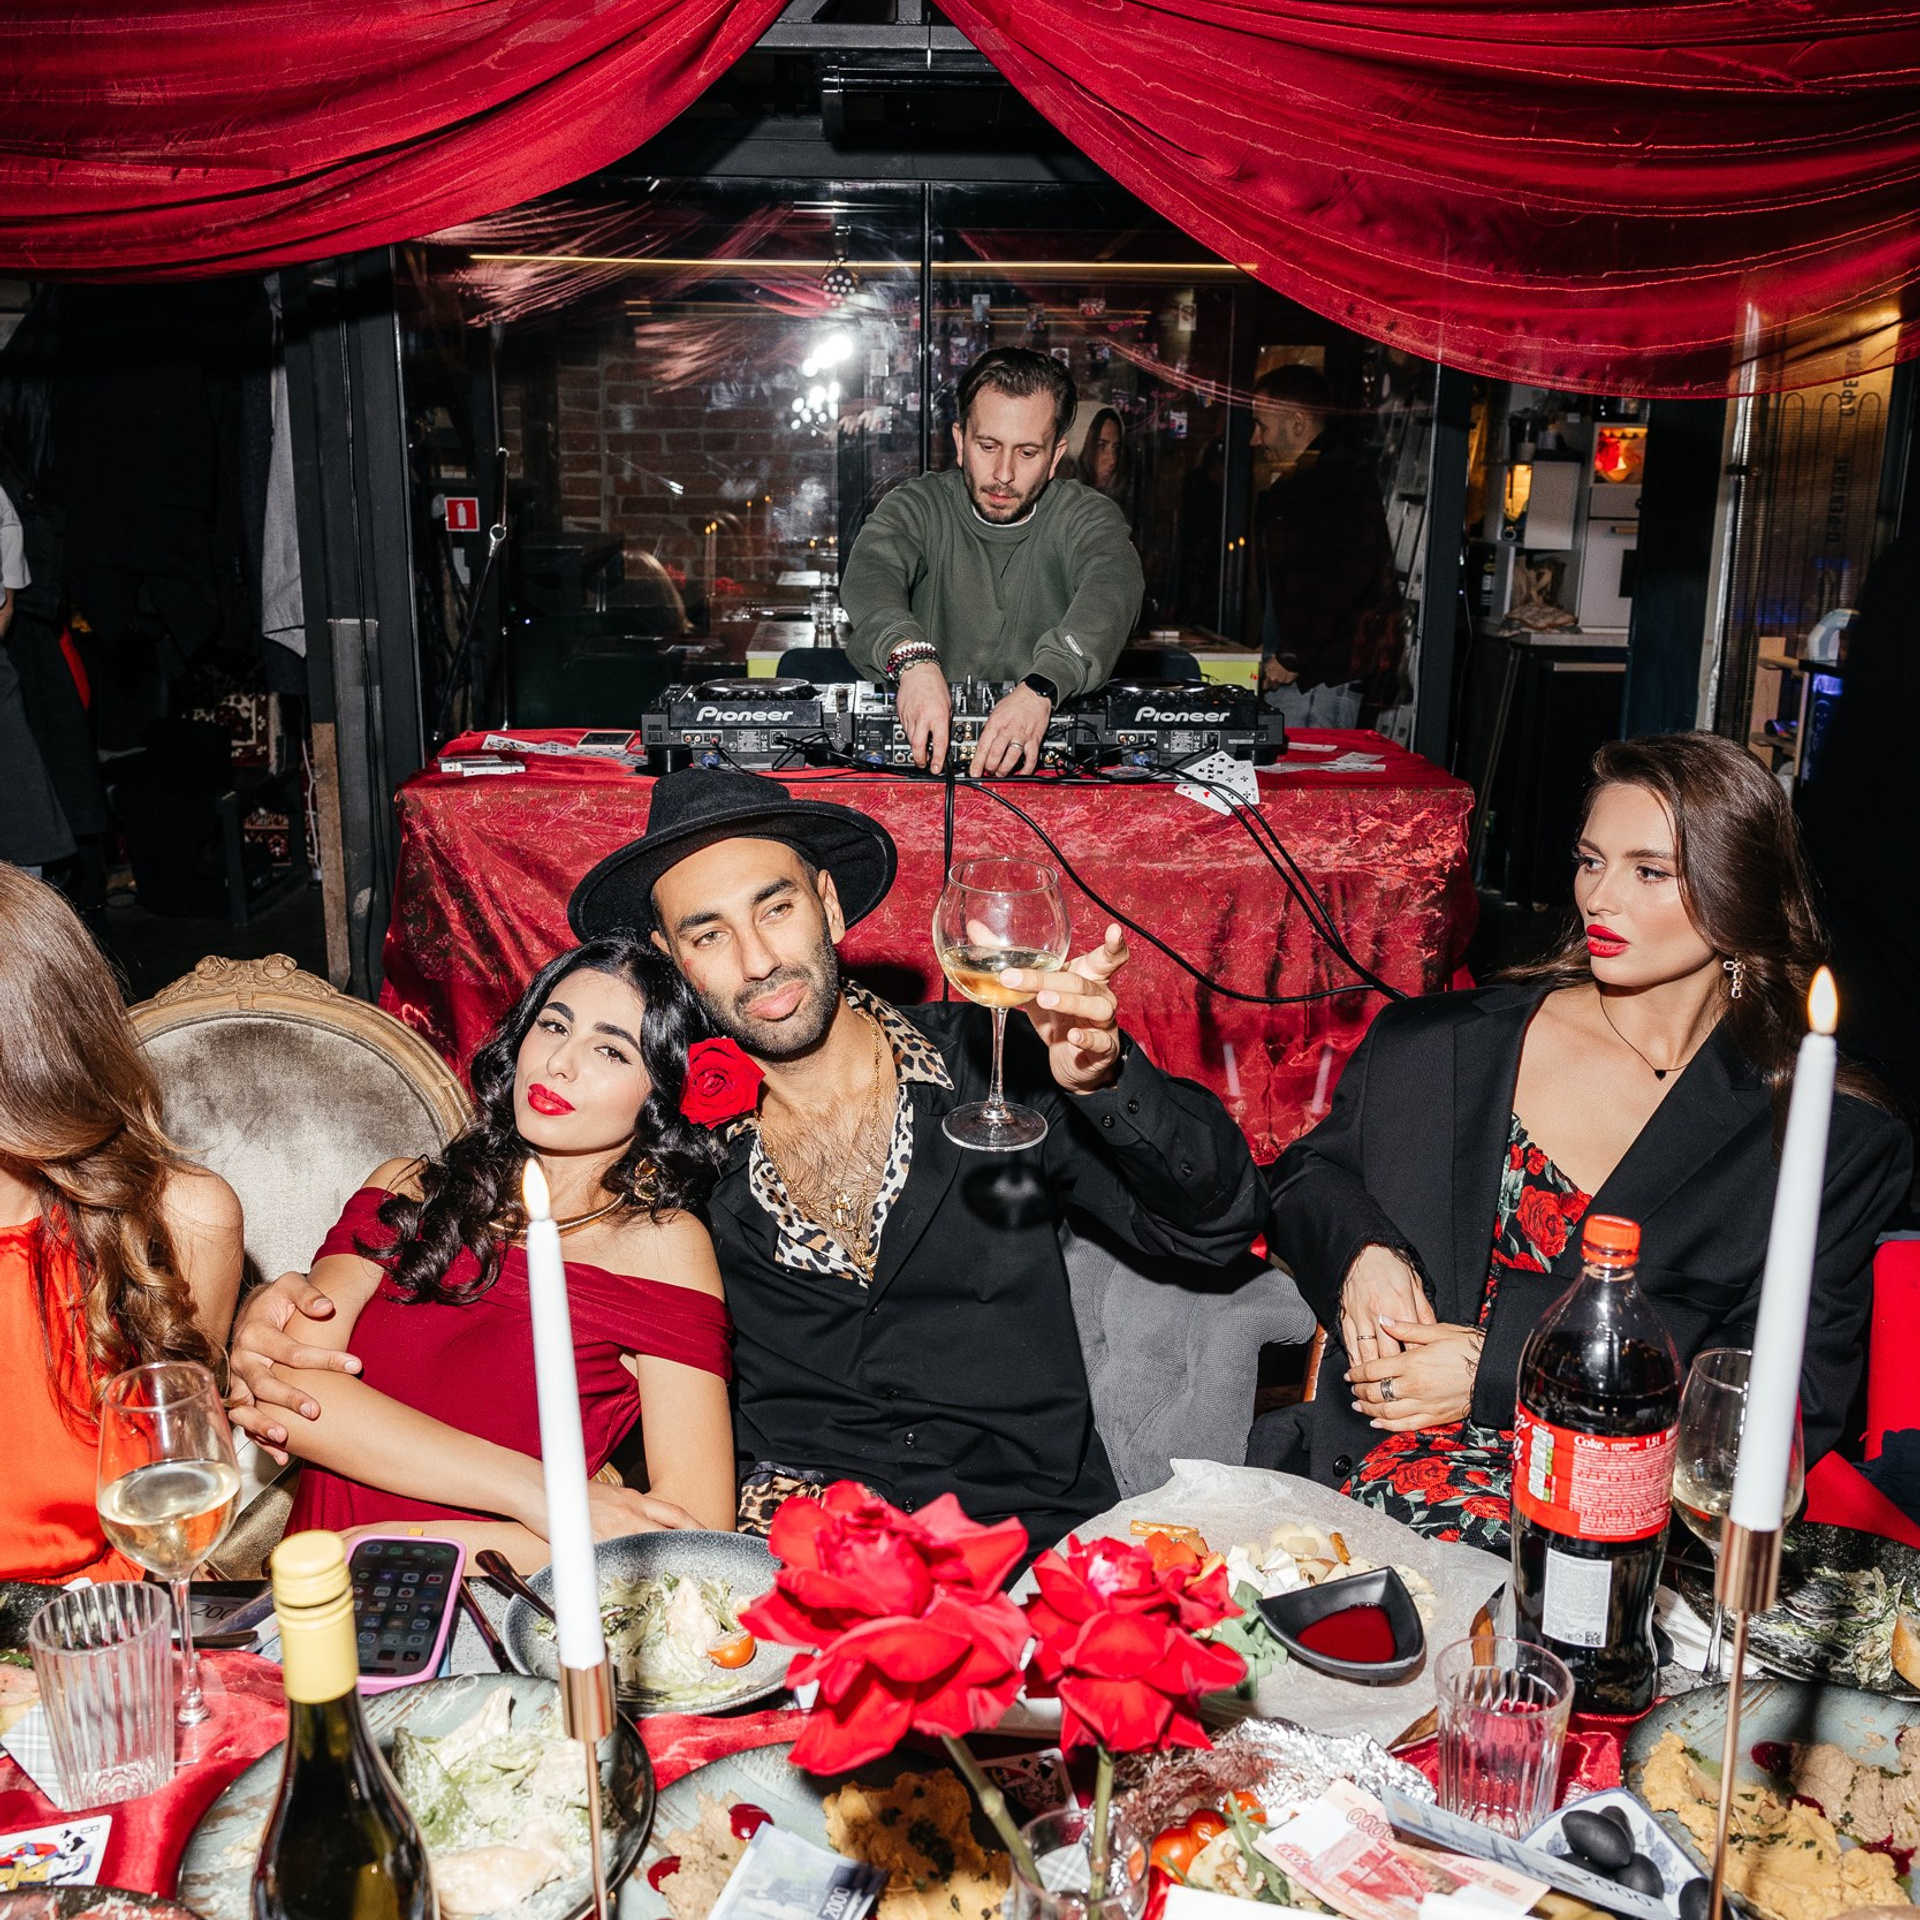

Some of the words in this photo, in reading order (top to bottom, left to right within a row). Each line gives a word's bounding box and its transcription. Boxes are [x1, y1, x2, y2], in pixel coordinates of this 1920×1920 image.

[695, 705, 794, 722] Pioneer
[1134, 706, 1231, 723] Pioneer
[1574, 1435, 1605, 1451] Coke
[822, 1886, 851, 1920] 2000
